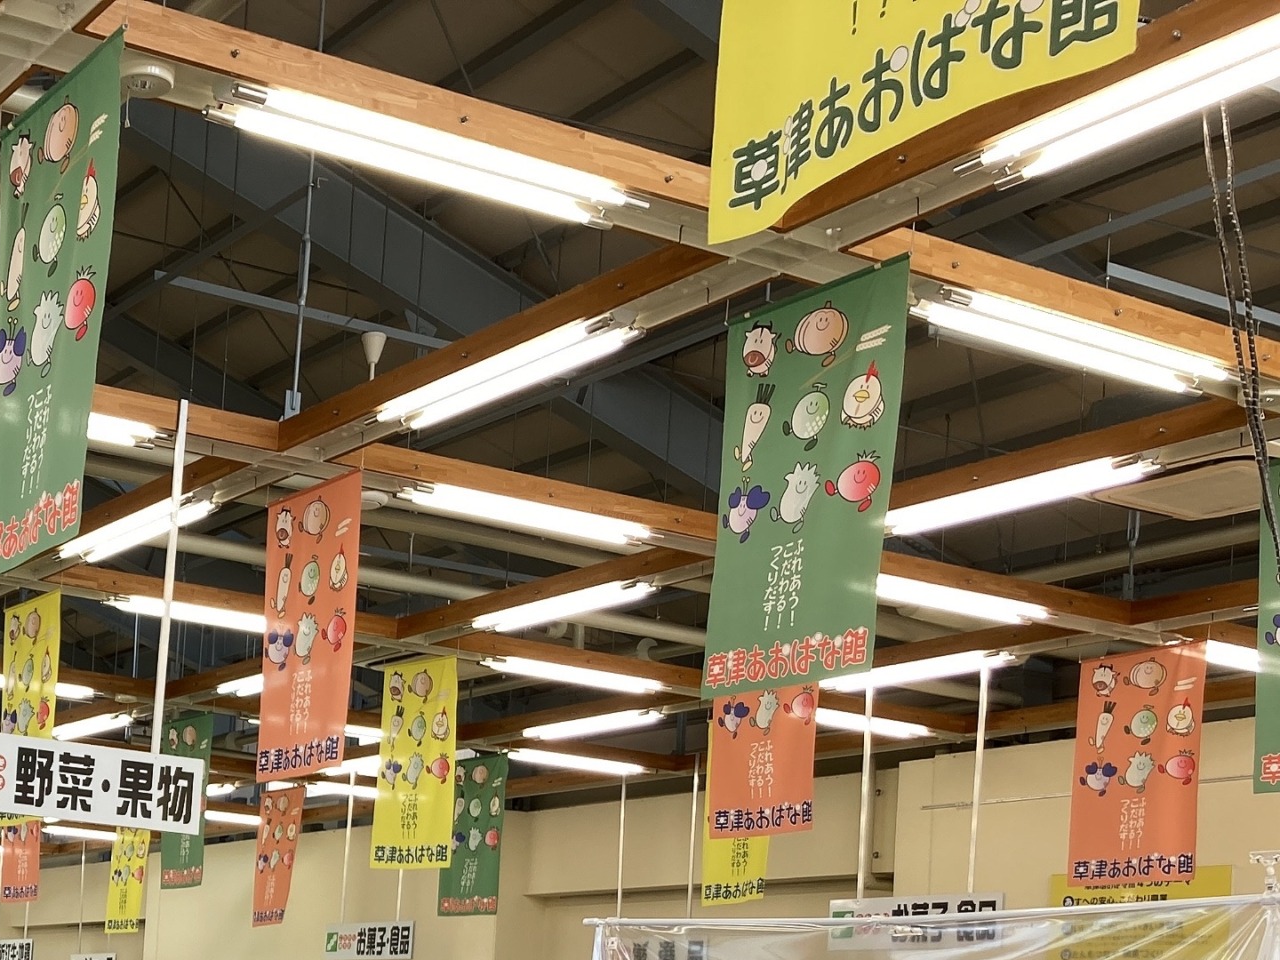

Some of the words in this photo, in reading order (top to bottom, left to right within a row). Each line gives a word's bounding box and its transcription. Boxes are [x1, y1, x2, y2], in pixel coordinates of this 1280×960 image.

[762, 545, 783, 631] つくりだす！
[776, 543, 795, 629] こだわる！
[788, 539, 804, 626] ふれあう！
[705, 626, 869, 688] 草津あおばな館
[258, 735, 340, 773] 草津あおばな館
[14, 746, 195, 825] 野菜・果物
[714, 801, 813, 832] 草津あおばな館
[374, 844, 448, 865] 草津あおばな館
[1073, 853, 1194, 881] 草津あおばな館
[356, 926, 410, 956] お菓子・食品
